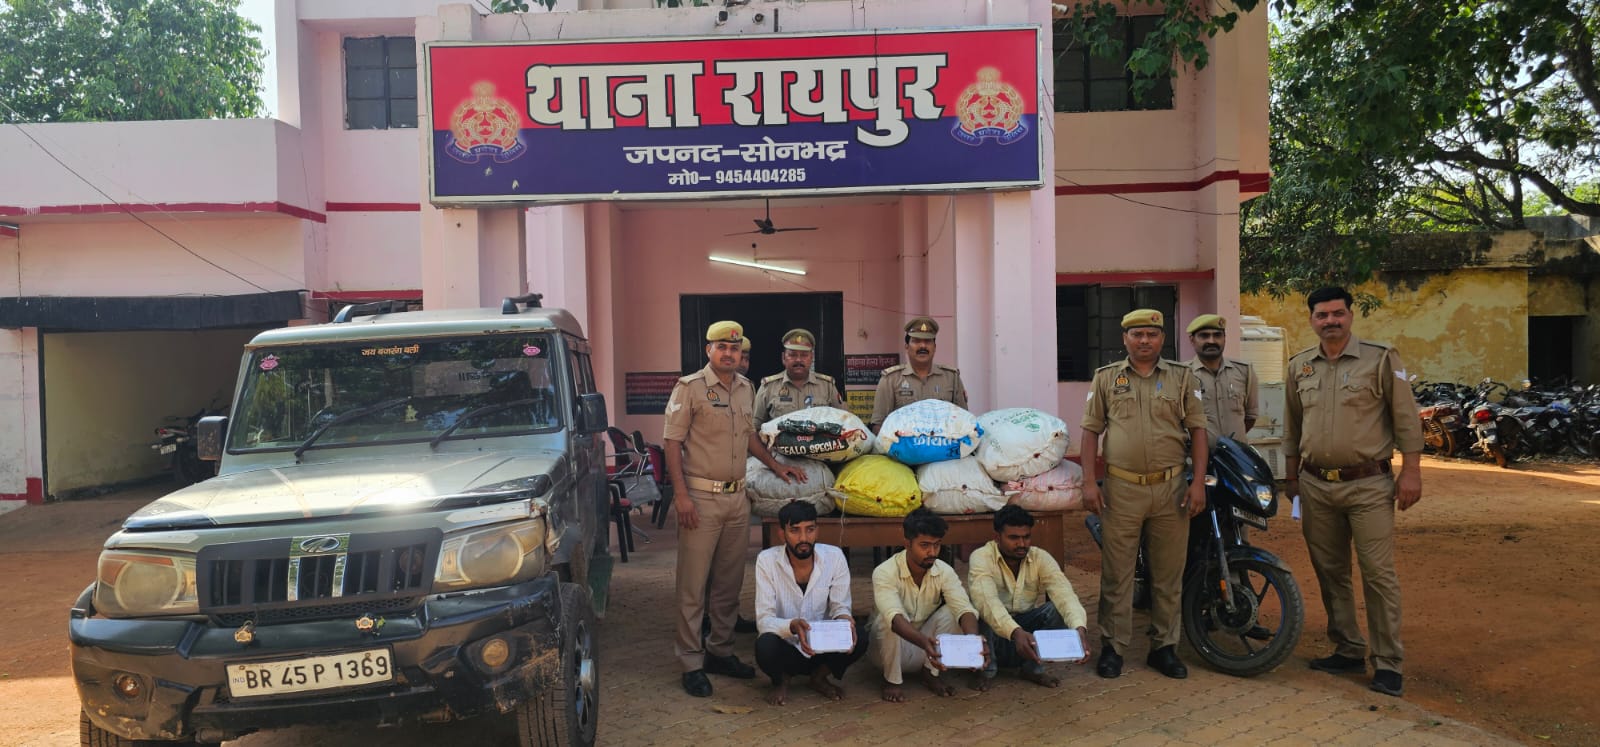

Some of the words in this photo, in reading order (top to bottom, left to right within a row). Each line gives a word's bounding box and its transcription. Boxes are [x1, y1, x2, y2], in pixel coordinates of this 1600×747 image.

[526, 61, 704, 130] थाना
[714, 53, 949, 147] रायपुर
[623, 136, 849, 164] जपनद-सोनभद्र
[715, 167, 806, 185] 9454404285
[378, 345, 402, 355] बजरंग
[403, 344, 420, 354] बली
[809, 439, 845, 454] SPECIAL
[246, 669, 272, 689] BR
[281, 667, 307, 687] 45
[313, 664, 325, 683] P
[334, 656, 388, 680] 1369
